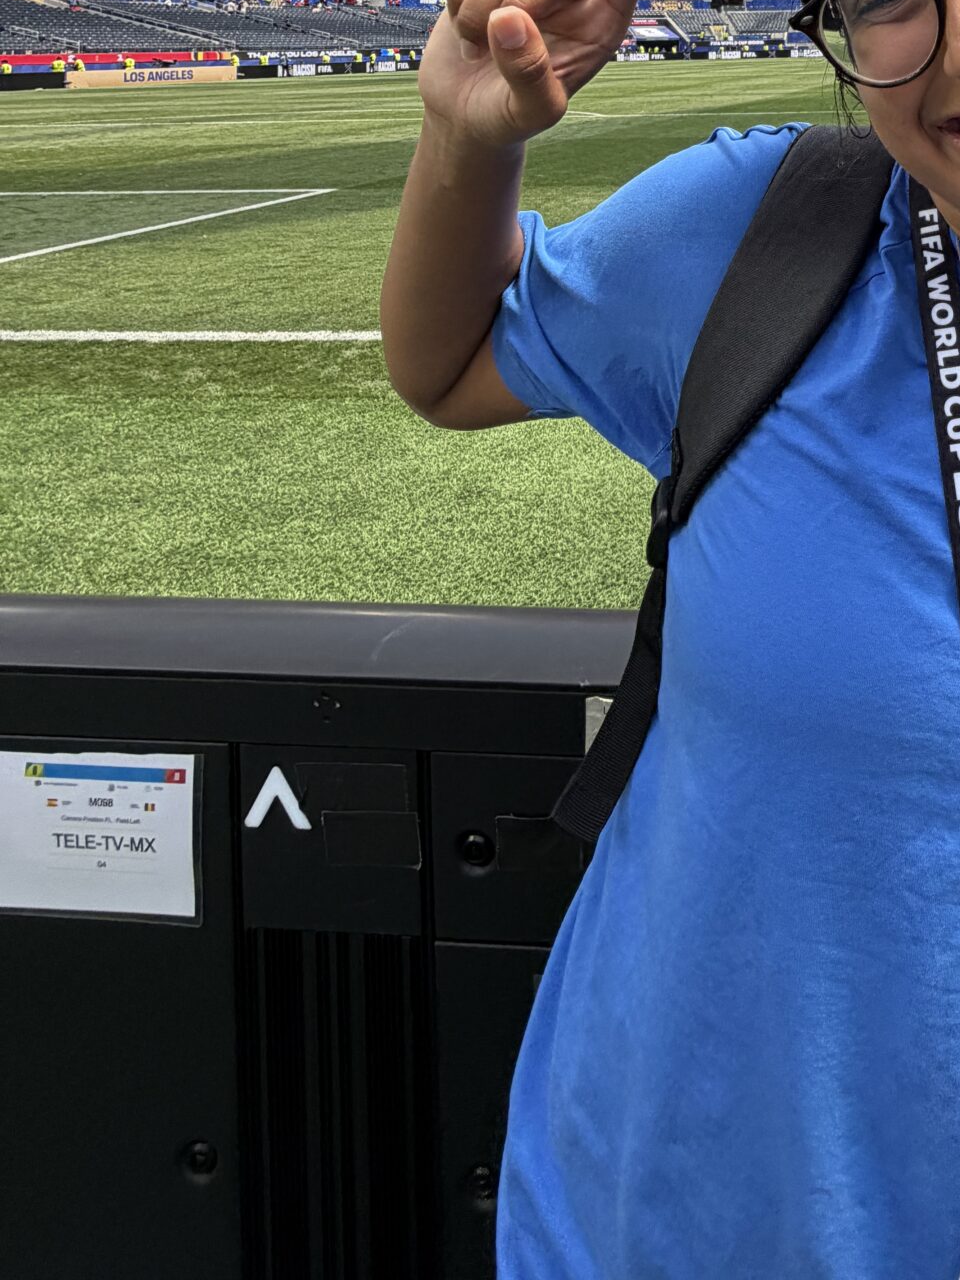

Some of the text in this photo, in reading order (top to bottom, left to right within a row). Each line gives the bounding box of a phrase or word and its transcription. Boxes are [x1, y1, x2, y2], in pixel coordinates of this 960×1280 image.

[247, 52, 280, 60] THNK
[302, 51, 319, 59] LOS
[651, 53, 664, 61] FIFA
[743, 51, 757, 59] FIFA
[318, 65, 333, 74] FIFA
[397, 62, 409, 70] FIFA
[124, 69, 194, 82] LOS ANGELES
[918, 208, 948, 273] FIFA
[52, 832, 157, 854] TELE-TV-MX
